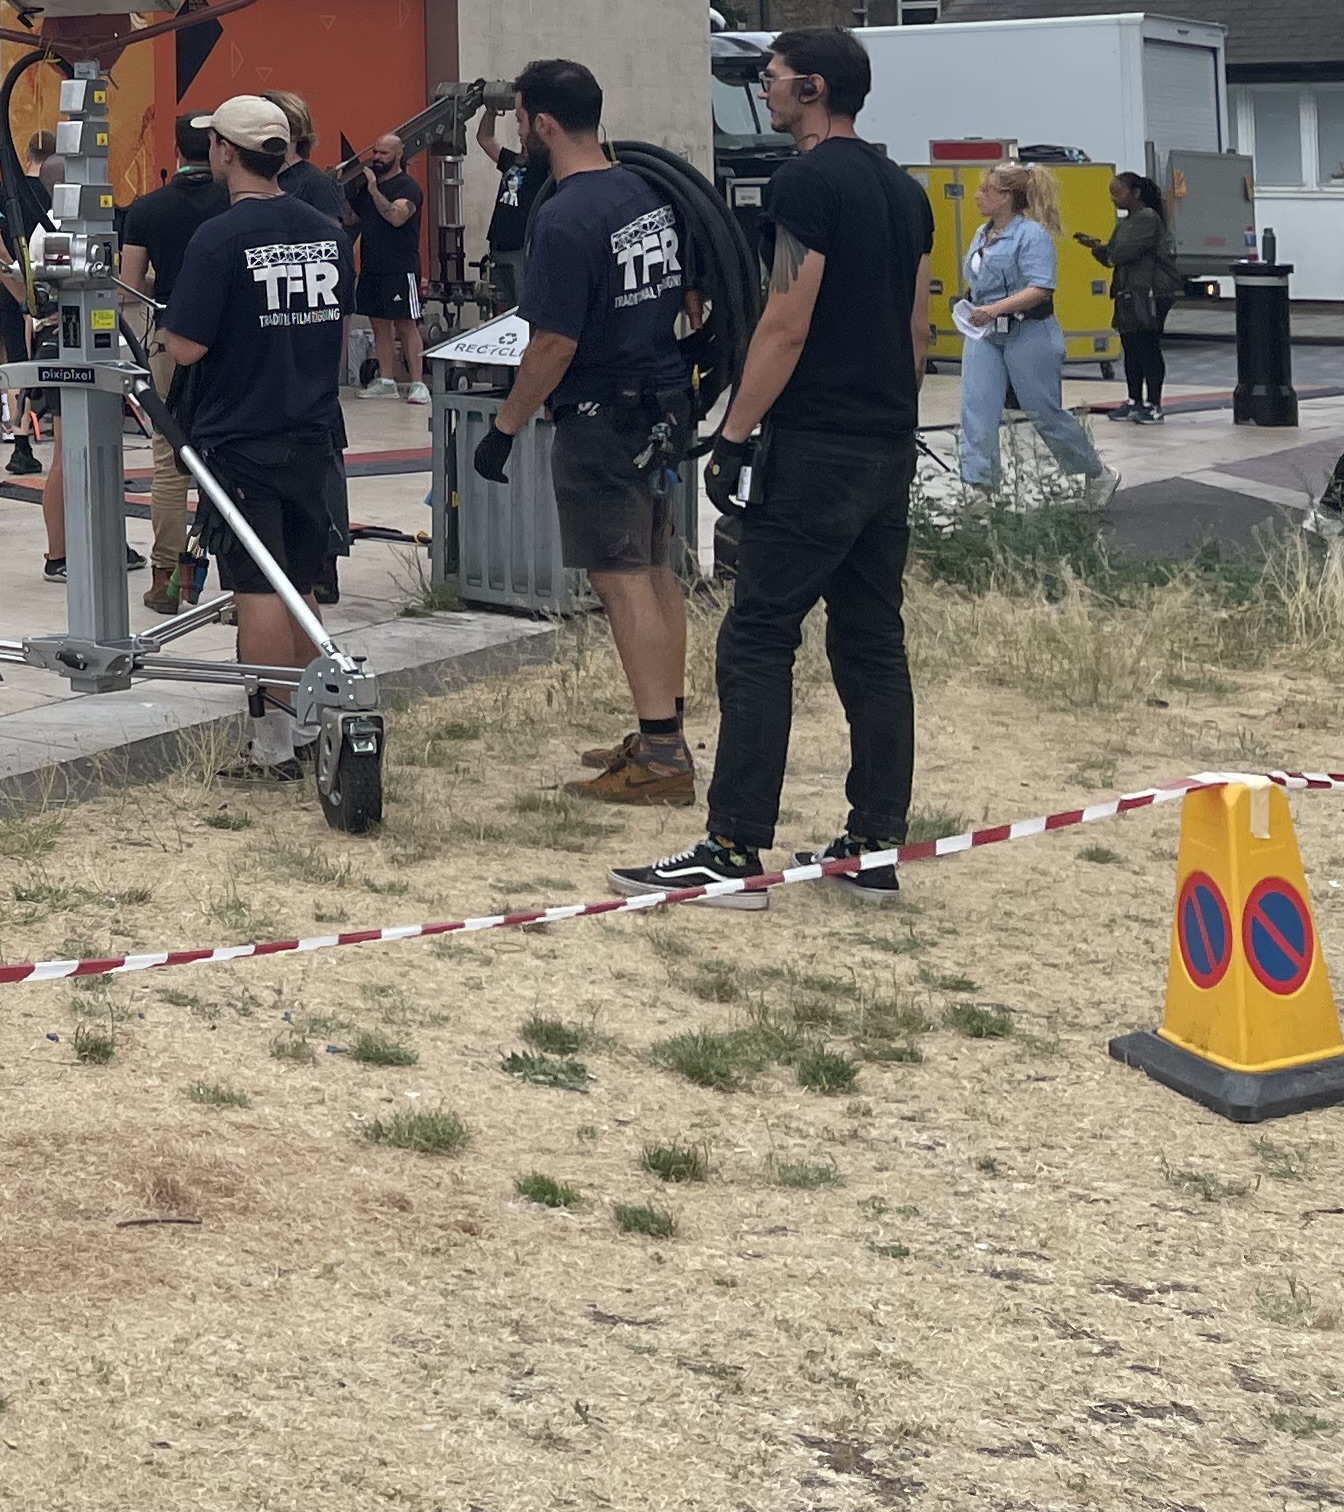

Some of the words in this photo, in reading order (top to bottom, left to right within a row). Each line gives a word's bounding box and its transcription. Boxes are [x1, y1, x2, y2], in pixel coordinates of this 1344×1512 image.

[617, 228, 681, 290] TFR
[253, 261, 340, 311] TFR
[292, 311, 311, 325] FILM
[454, 343, 525, 358] RECYCLI
[42, 368, 92, 381] pixipixel
